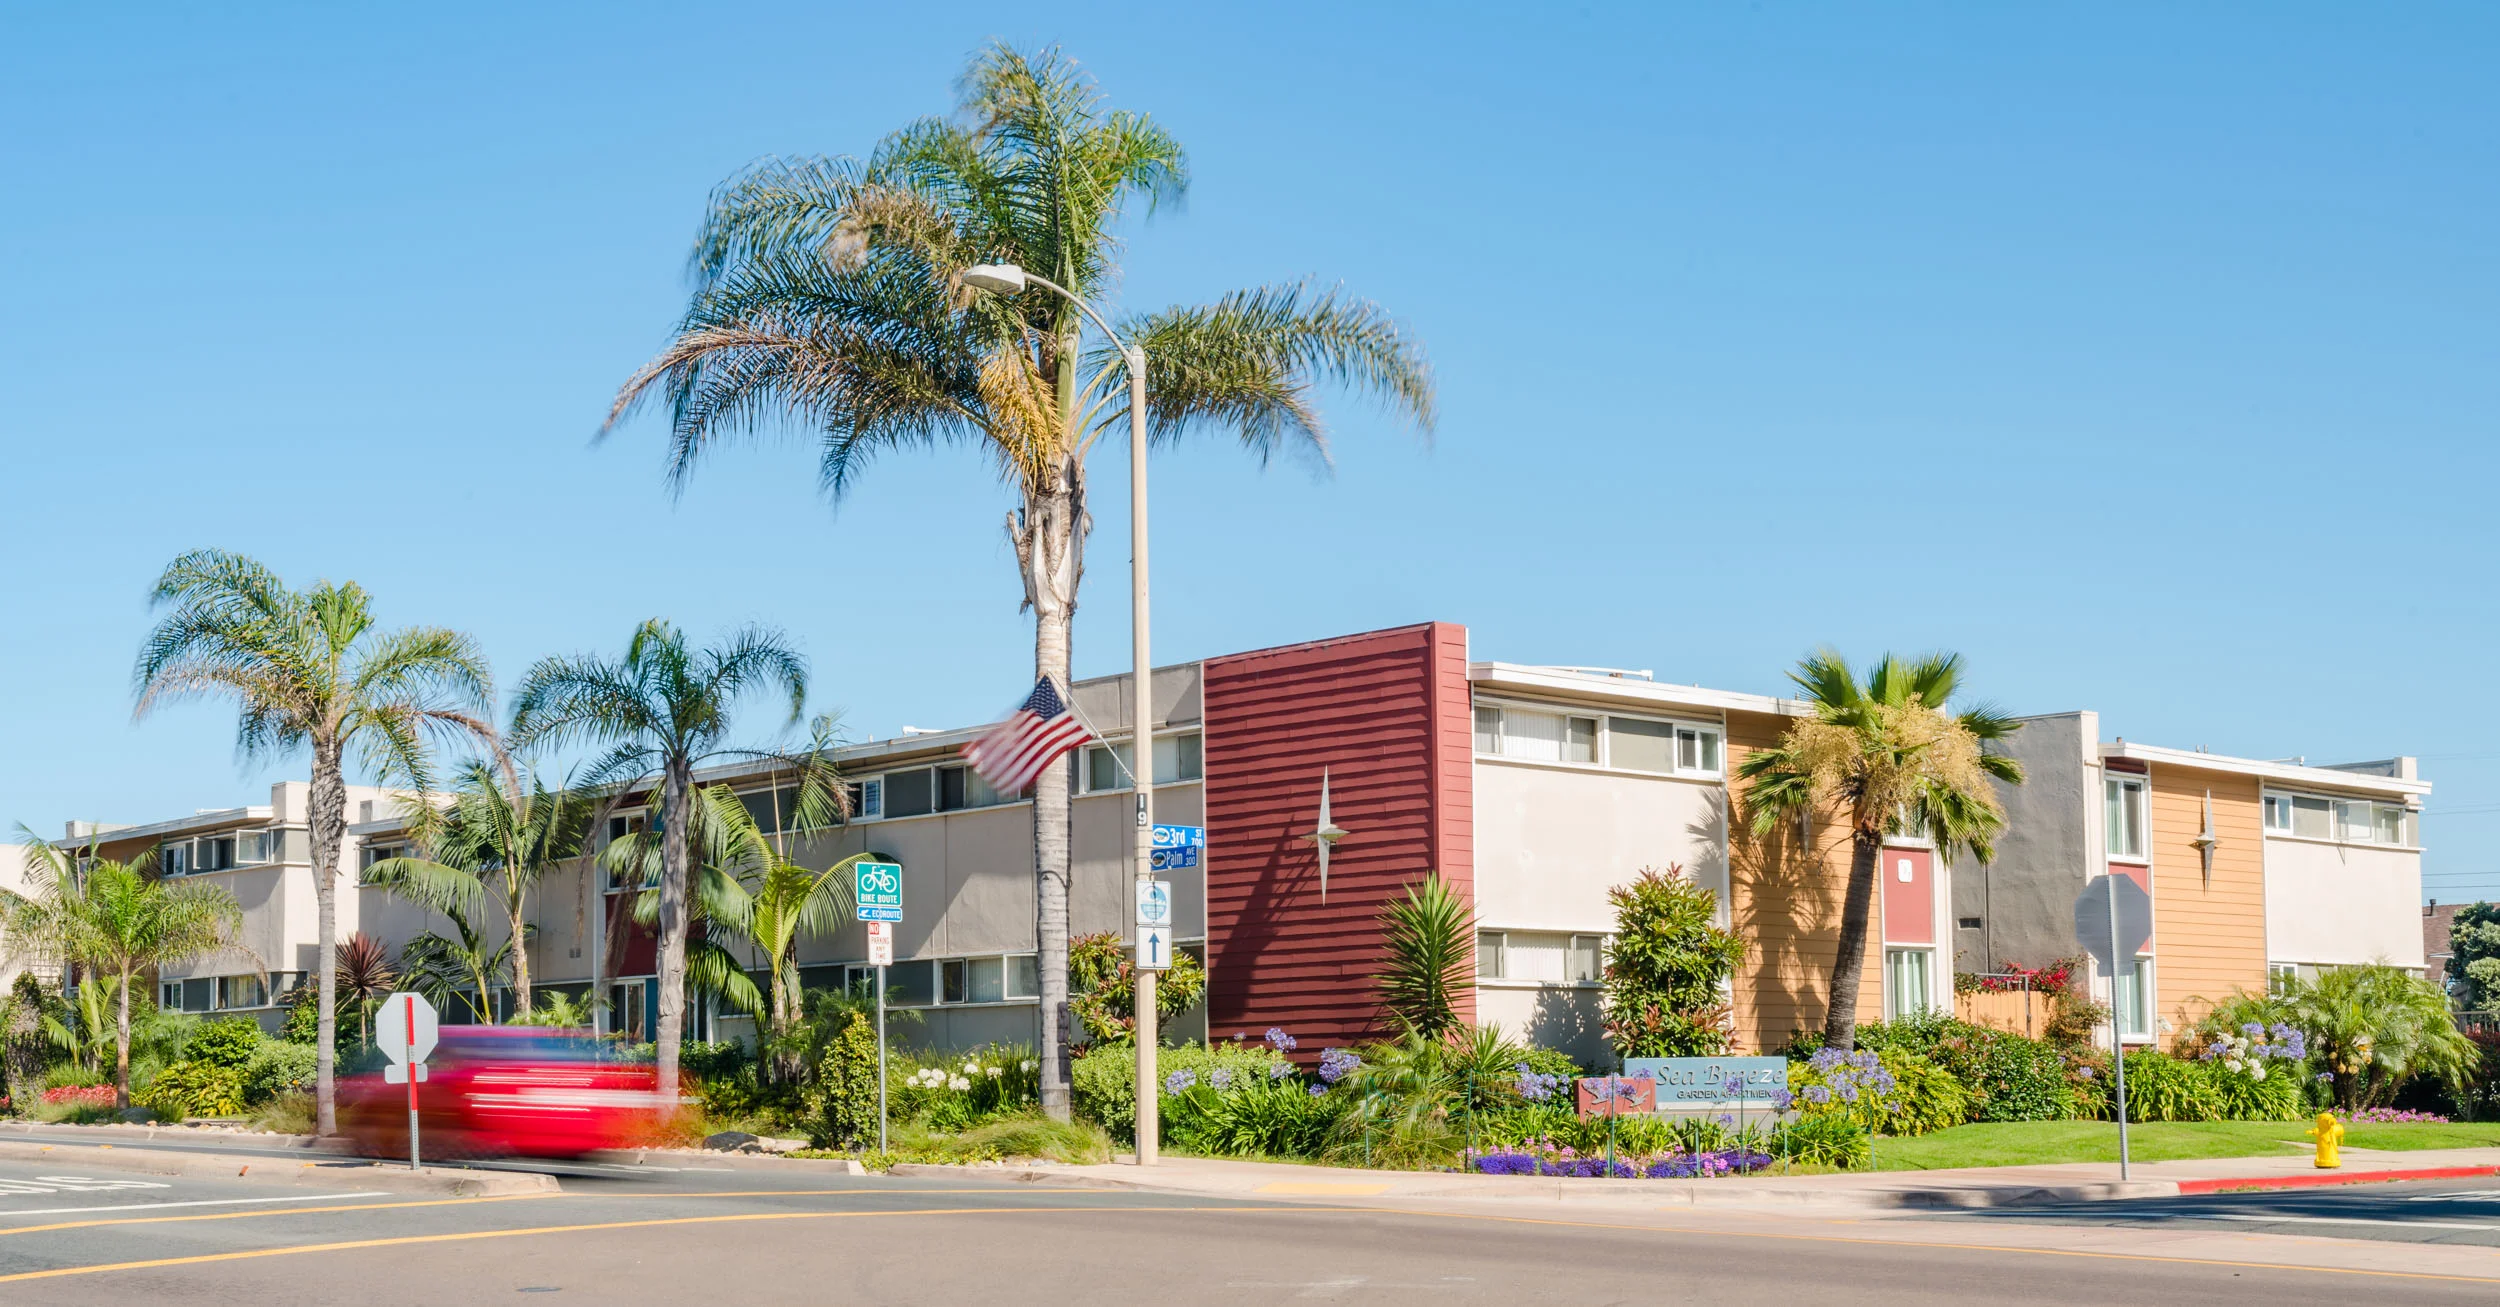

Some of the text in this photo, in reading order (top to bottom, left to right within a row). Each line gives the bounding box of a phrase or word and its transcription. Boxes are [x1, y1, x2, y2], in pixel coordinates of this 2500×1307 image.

[1170, 828, 1202, 844] 3rd ST
[1166, 847, 1195, 867] Palm AVE
[1185, 857, 1196, 866] 300
[861, 893, 898, 904] BIKE ROUTE
[871, 909, 901, 918] ECOROUTE
[870, 923, 879, 934] NO
[1656, 1064, 1696, 1086] Sea
[1676, 1088, 1781, 1100] GARDEN APATMEN
